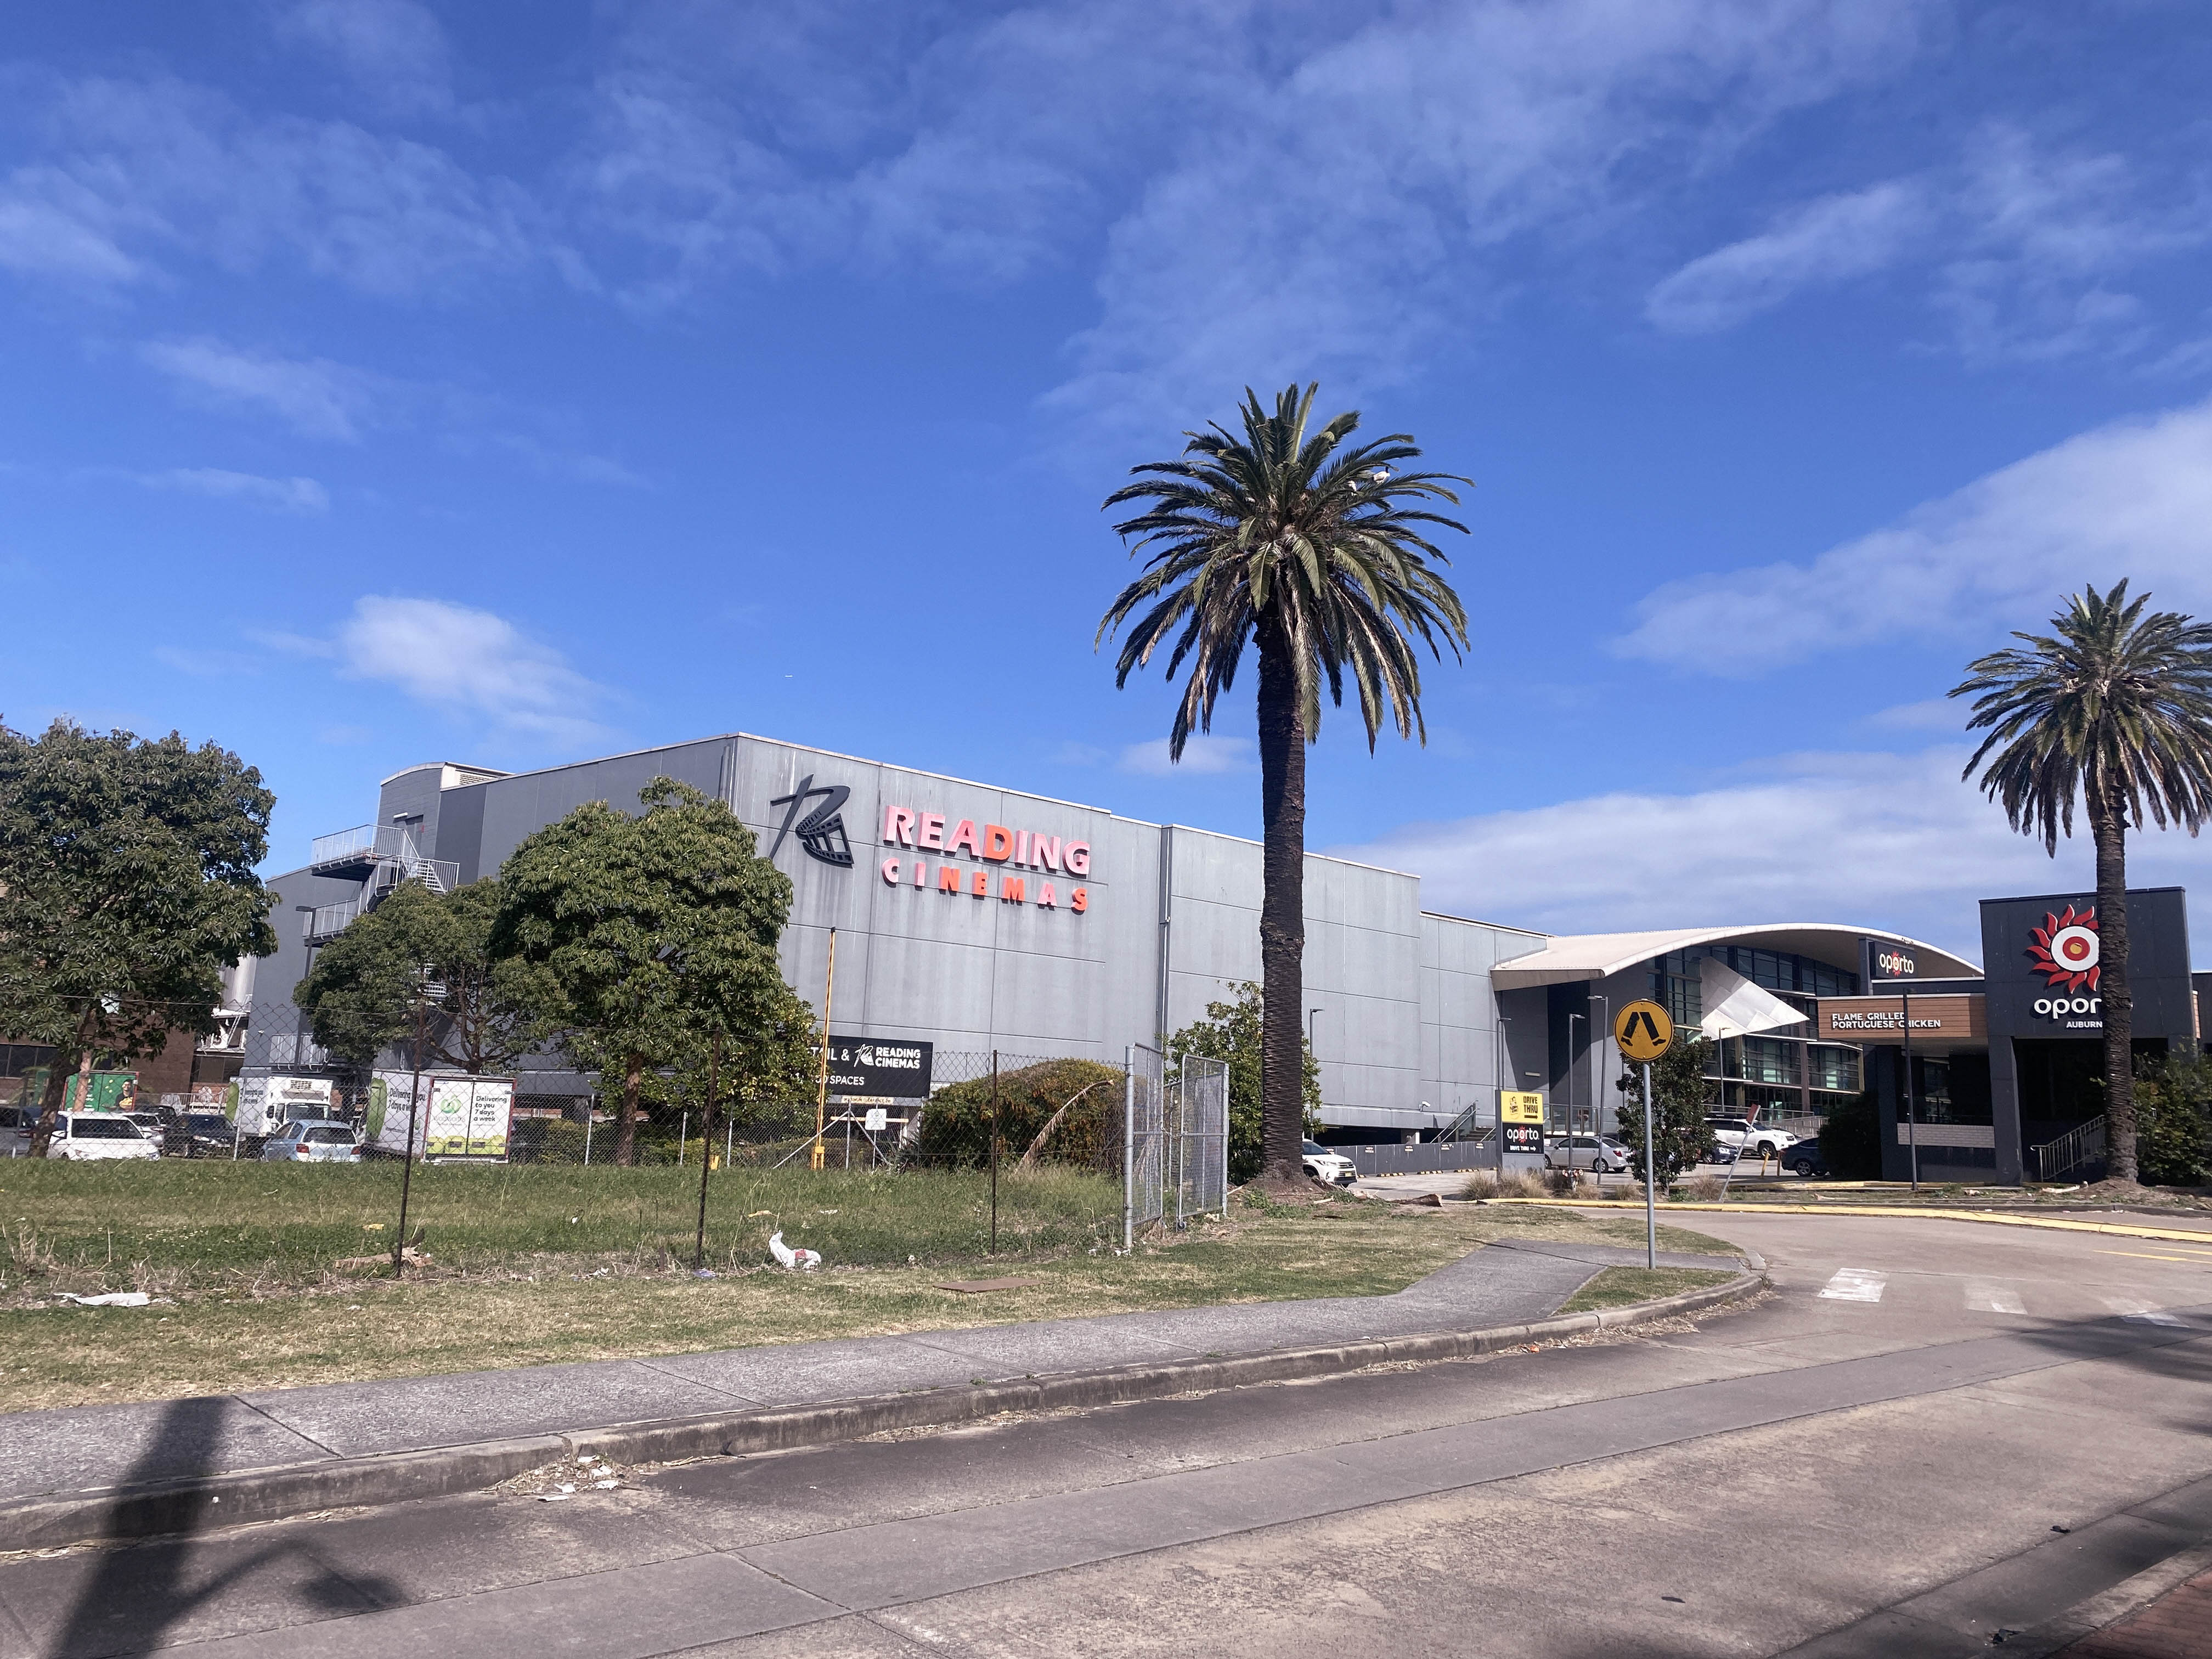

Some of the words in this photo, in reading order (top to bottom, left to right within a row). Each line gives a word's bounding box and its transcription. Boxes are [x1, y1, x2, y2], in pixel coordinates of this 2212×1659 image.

[882, 805, 1091, 876] READING
[882, 857, 1088, 911] CINEMAS
[1879, 953, 1914, 974] oporto
[2034, 997, 2133, 1019] opor
[1867, 1012, 1905, 1020] GRILLED
[1832, 1020, 1895, 1029] PORTUGUESE
[841, 1048, 849, 1061] &
[876, 1047, 921, 1059] READING
[875, 1058, 920, 1069] CINEMAS
[830, 1075, 865, 1085] SPACES
[476, 1096, 507, 1104] Delivering
[1523, 1096, 1538, 1104] DRIVE
[1523, 1104, 1538, 1113] THRU
[1506, 1127, 1539, 1143] oporto
